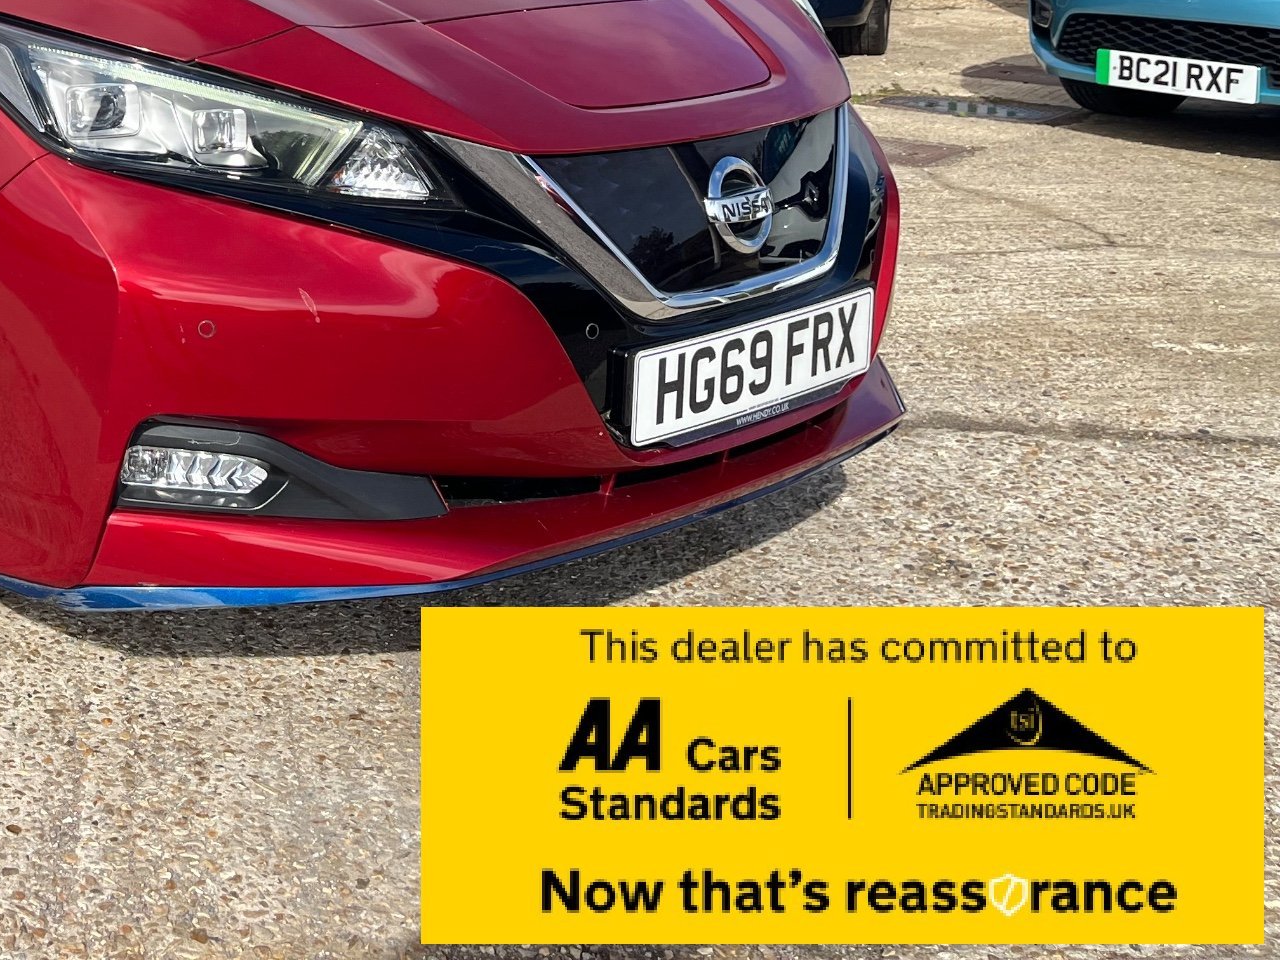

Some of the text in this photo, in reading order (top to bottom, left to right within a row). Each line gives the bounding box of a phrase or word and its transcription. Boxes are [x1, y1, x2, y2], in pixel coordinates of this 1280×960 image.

[1118, 54, 1244, 94] BC21 RXF
[655, 302, 858, 426] HG69 FRX
